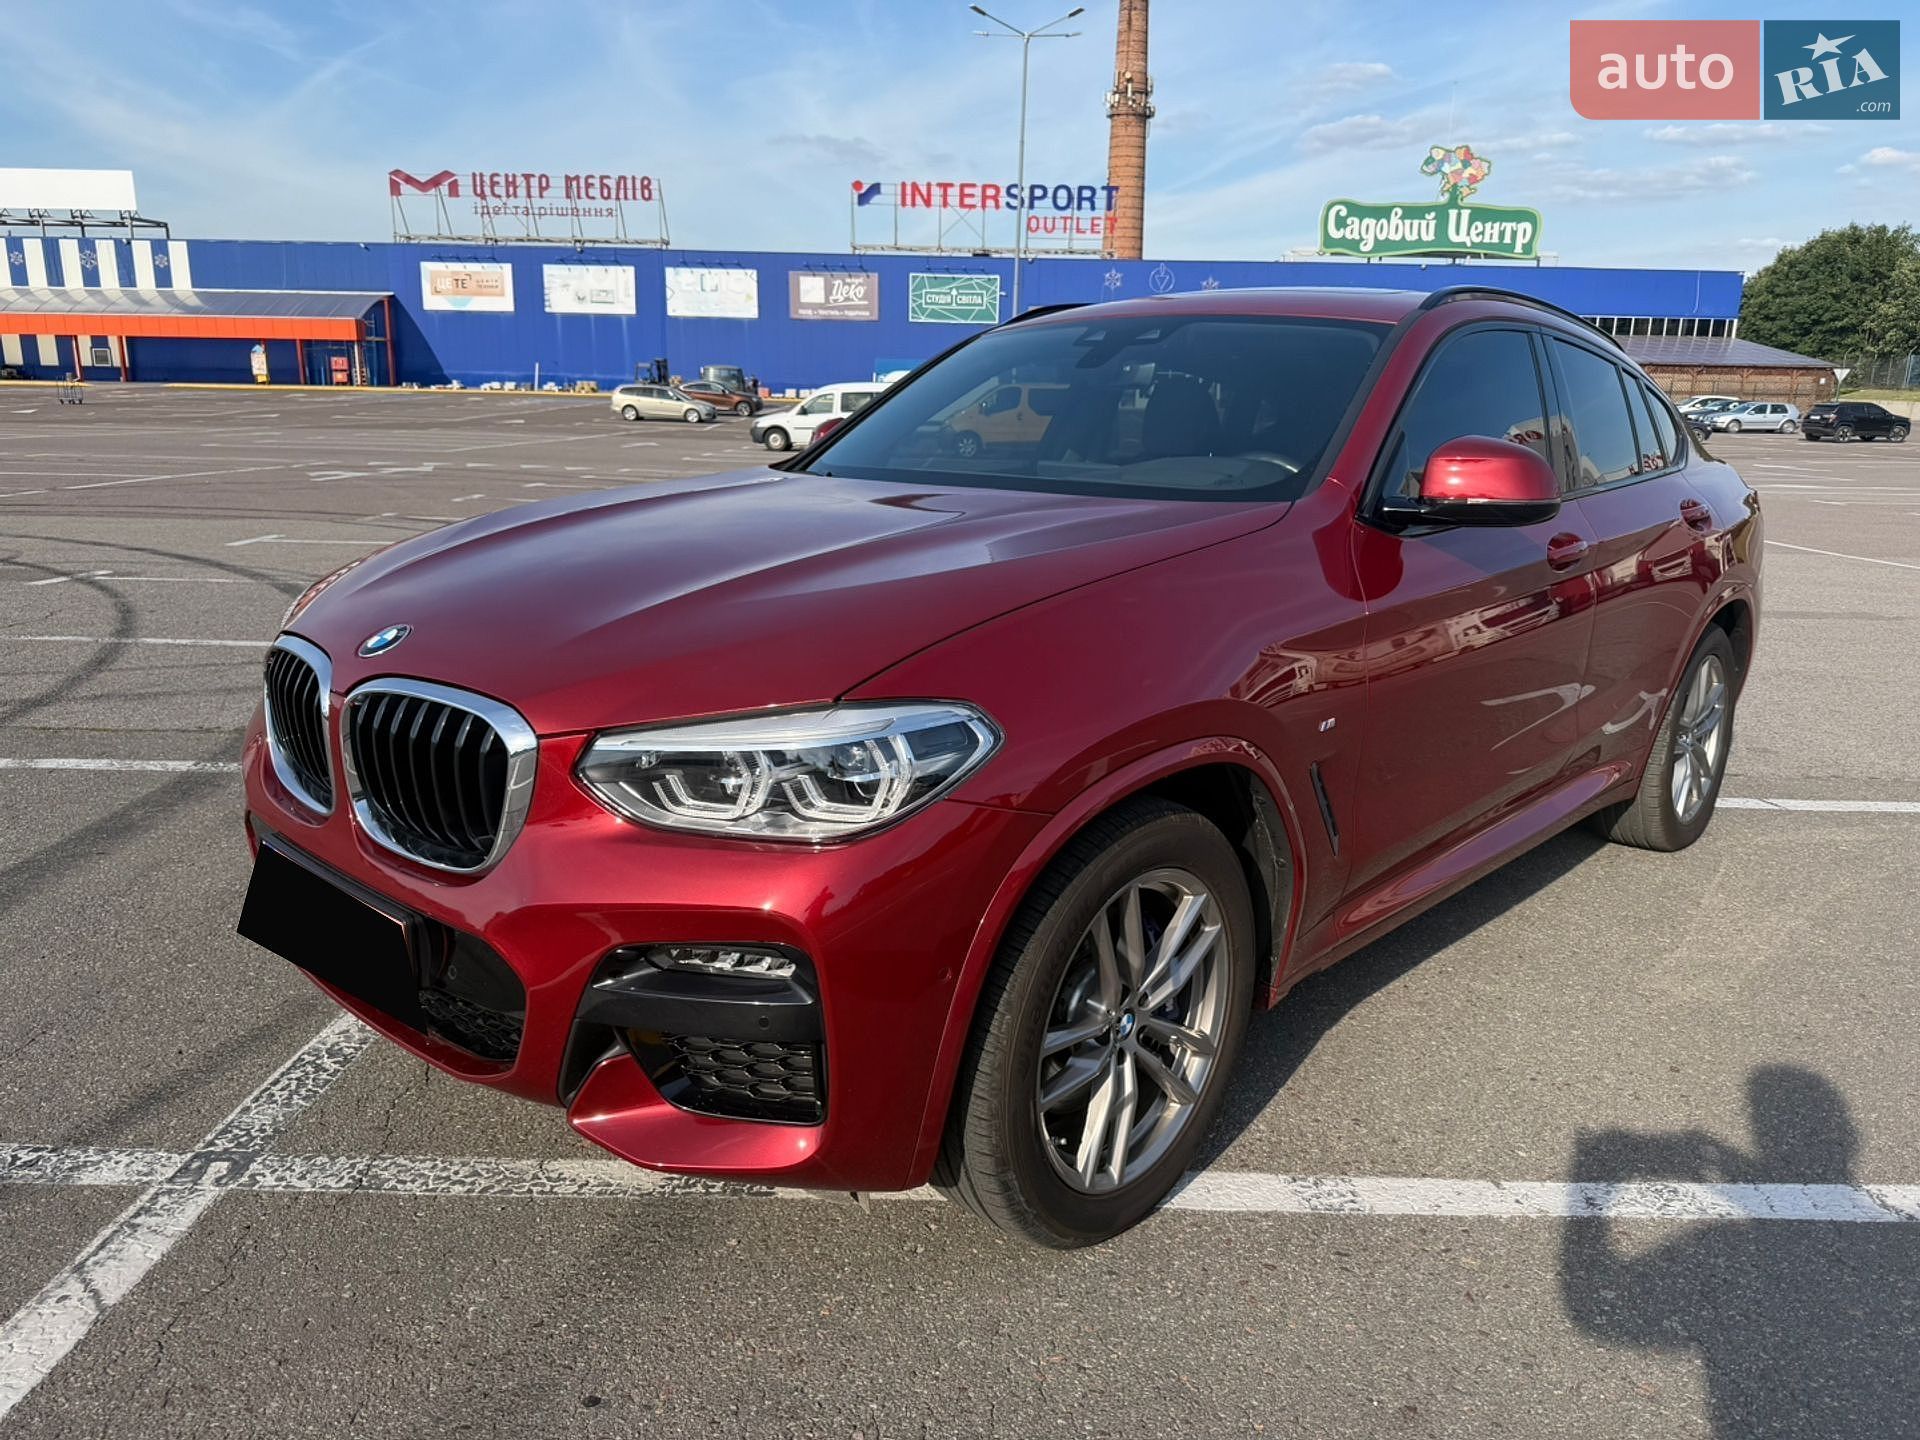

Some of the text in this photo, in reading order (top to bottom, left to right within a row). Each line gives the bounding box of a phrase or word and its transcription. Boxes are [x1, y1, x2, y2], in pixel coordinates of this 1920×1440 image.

[472, 172, 551, 199] ЦЕНТР
[900, 181, 1120, 212] INTERSPORT
[1026, 215, 1119, 234] OUTLET
[1327, 205, 1533, 253] Садовий Центр
